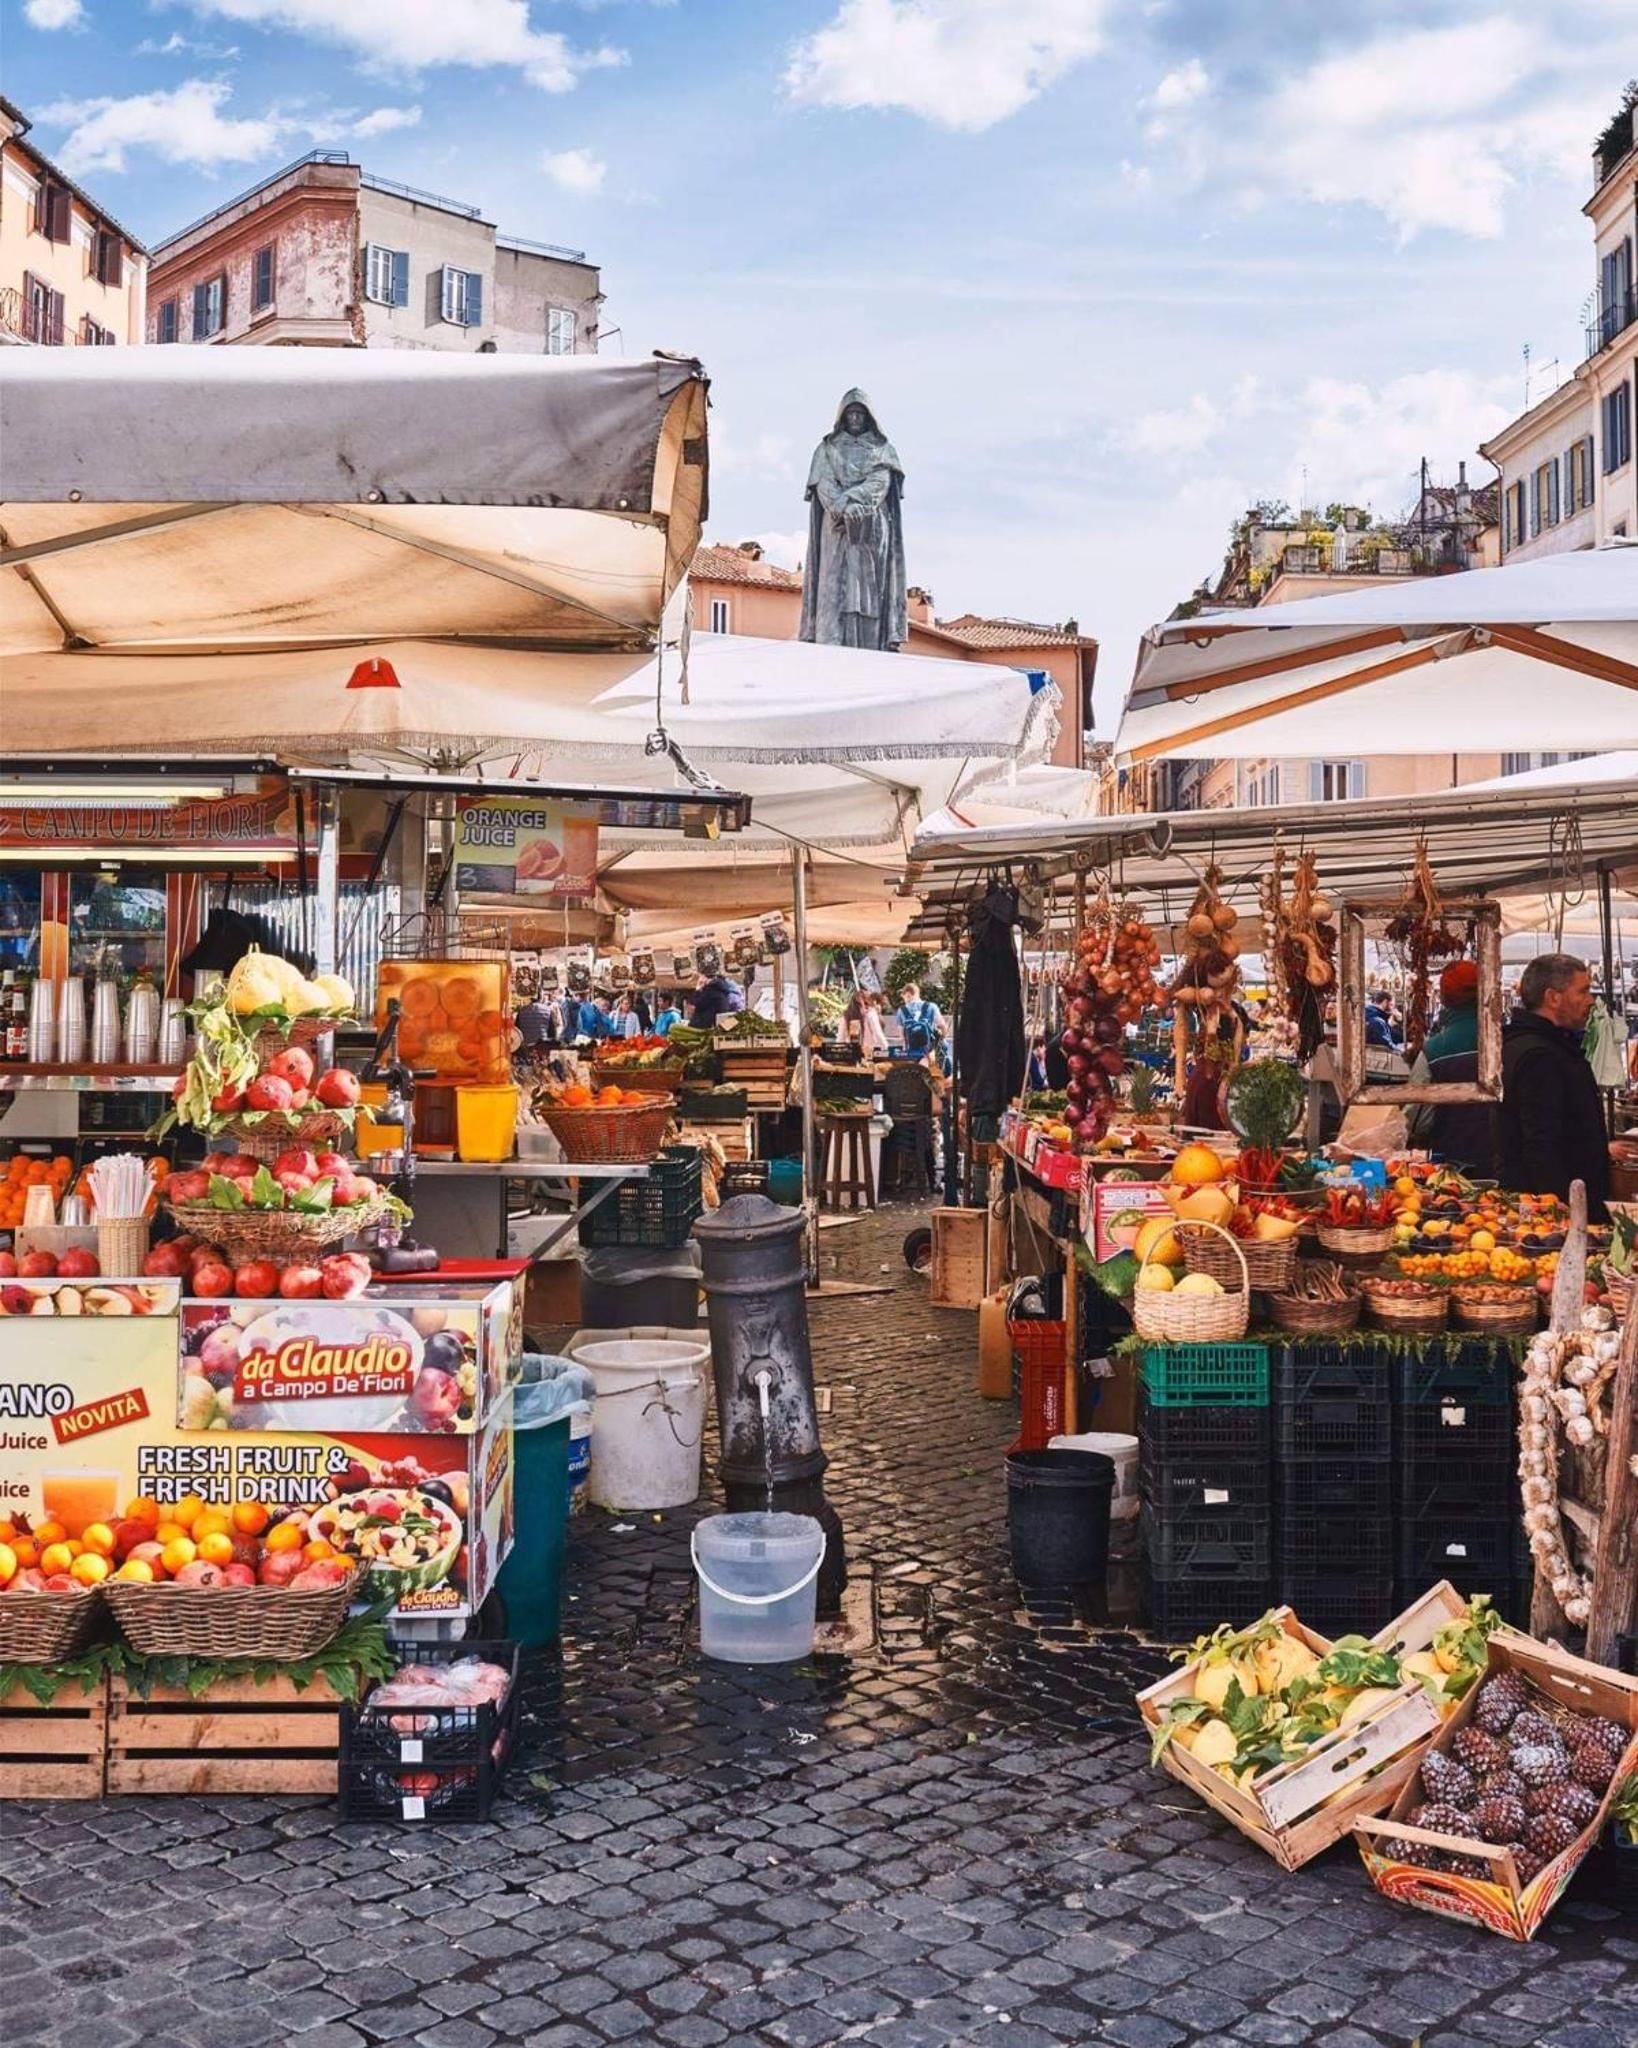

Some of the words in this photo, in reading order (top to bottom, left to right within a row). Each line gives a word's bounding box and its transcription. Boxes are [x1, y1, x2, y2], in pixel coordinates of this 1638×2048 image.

[22, 804, 128, 839] CAMPO
[188, 802, 269, 840] FIORI
[461, 808, 546, 829] ORANGE
[460, 826, 516, 847] JUICE
[242, 1352, 276, 1380] da
[279, 1337, 408, 1378] Claudio
[243, 1384, 255, 1398] a
[260, 1379, 327, 1398] Campo
[59, 1393, 141, 1437] NOVITÀ
[138, 1446, 231, 1474] FRESH
[236, 1446, 323, 1474] FRUIT
[326, 1446, 350, 1474] &
[0, 1481, 30, 1497] ice
[138, 1475, 231, 1504] FRESH
[236, 1475, 332, 1504] DRINK
[413, 1588, 458, 1604] Claudio
